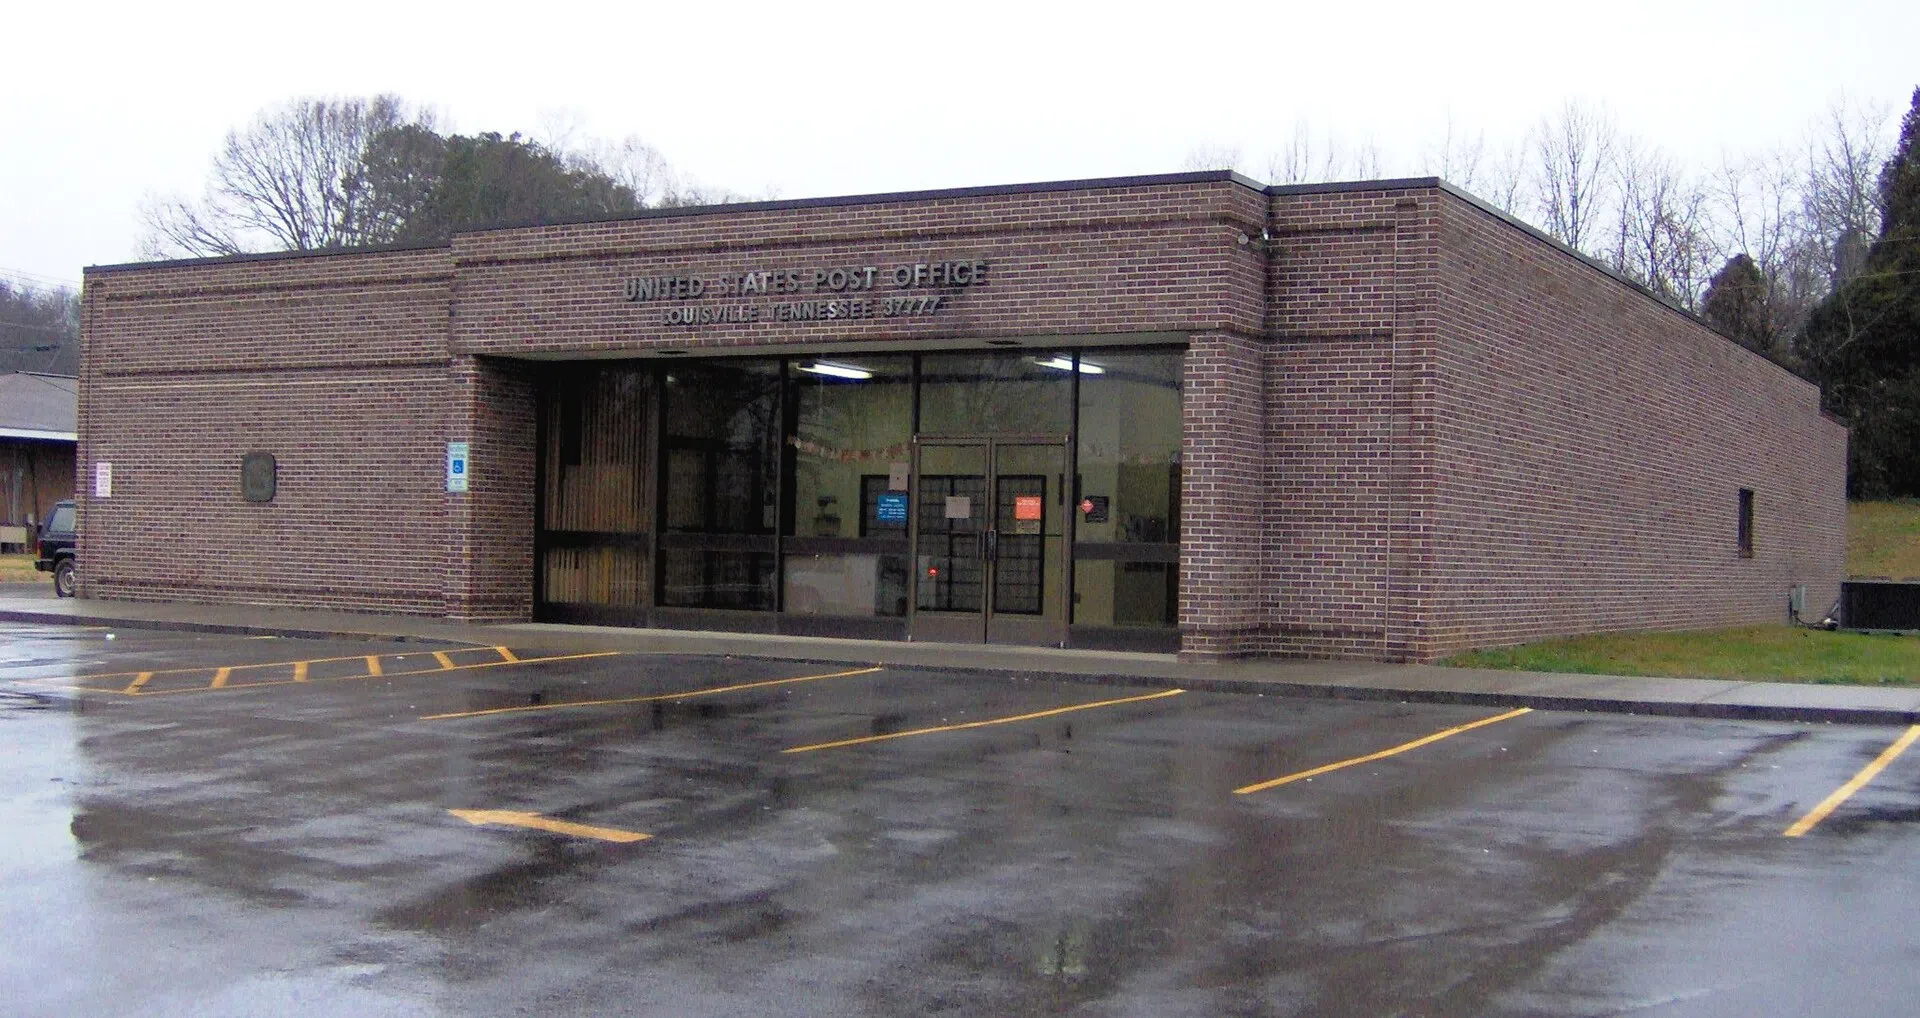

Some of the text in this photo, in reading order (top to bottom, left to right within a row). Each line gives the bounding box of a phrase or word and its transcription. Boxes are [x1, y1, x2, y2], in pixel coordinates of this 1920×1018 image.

[623, 260, 986, 301] UNITED STATES POST OFFICE
[663, 305, 759, 325] LOUISVILLE
[770, 300, 873, 321] TENNESSEE
